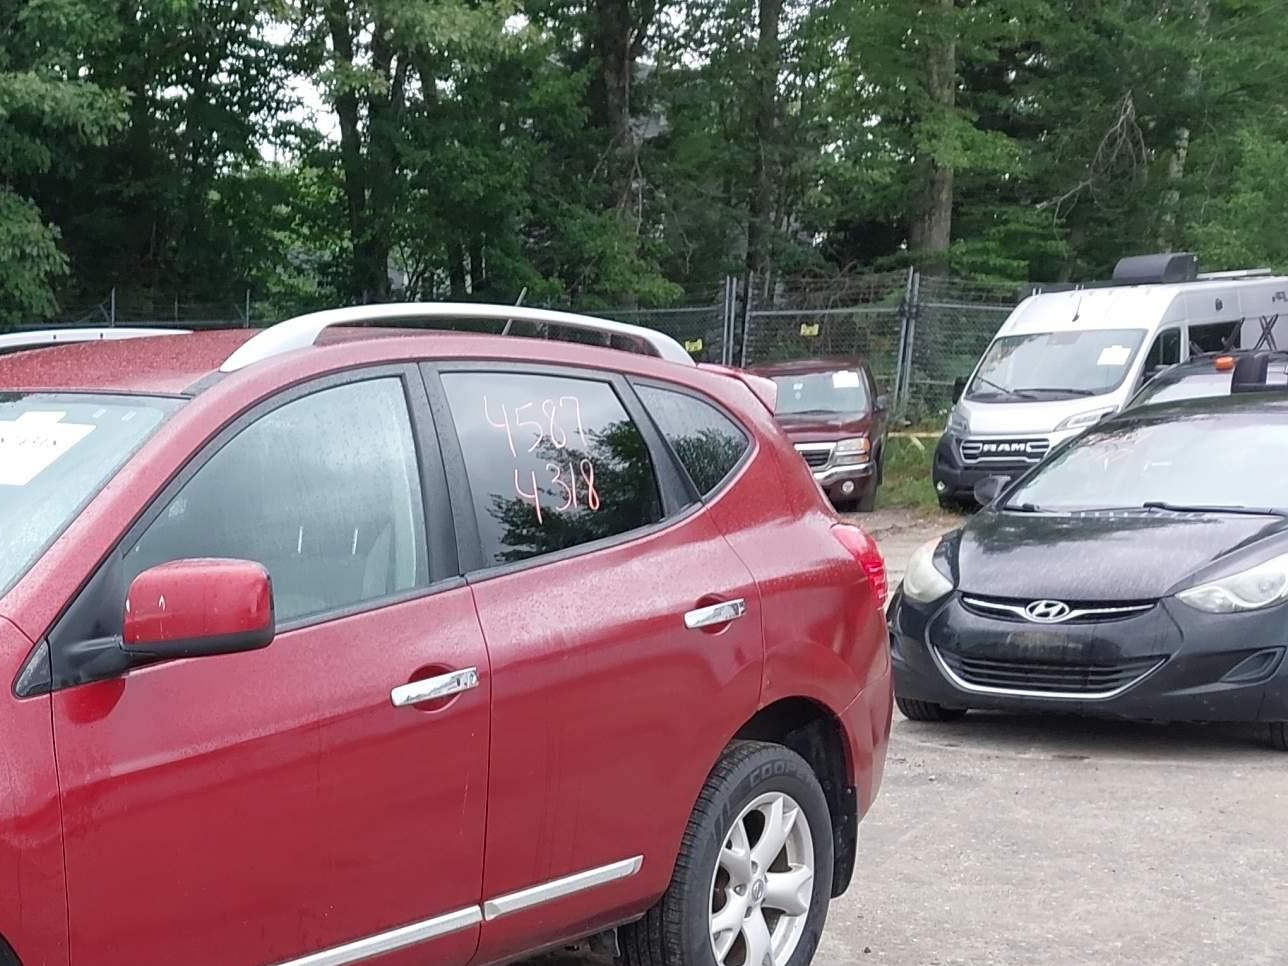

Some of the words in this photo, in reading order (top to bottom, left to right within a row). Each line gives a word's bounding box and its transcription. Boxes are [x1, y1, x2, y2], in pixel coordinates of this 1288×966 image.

[482, 395, 588, 458] 4587
[983, 443, 1025, 453] RAM
[514, 458, 600, 525] 4318
